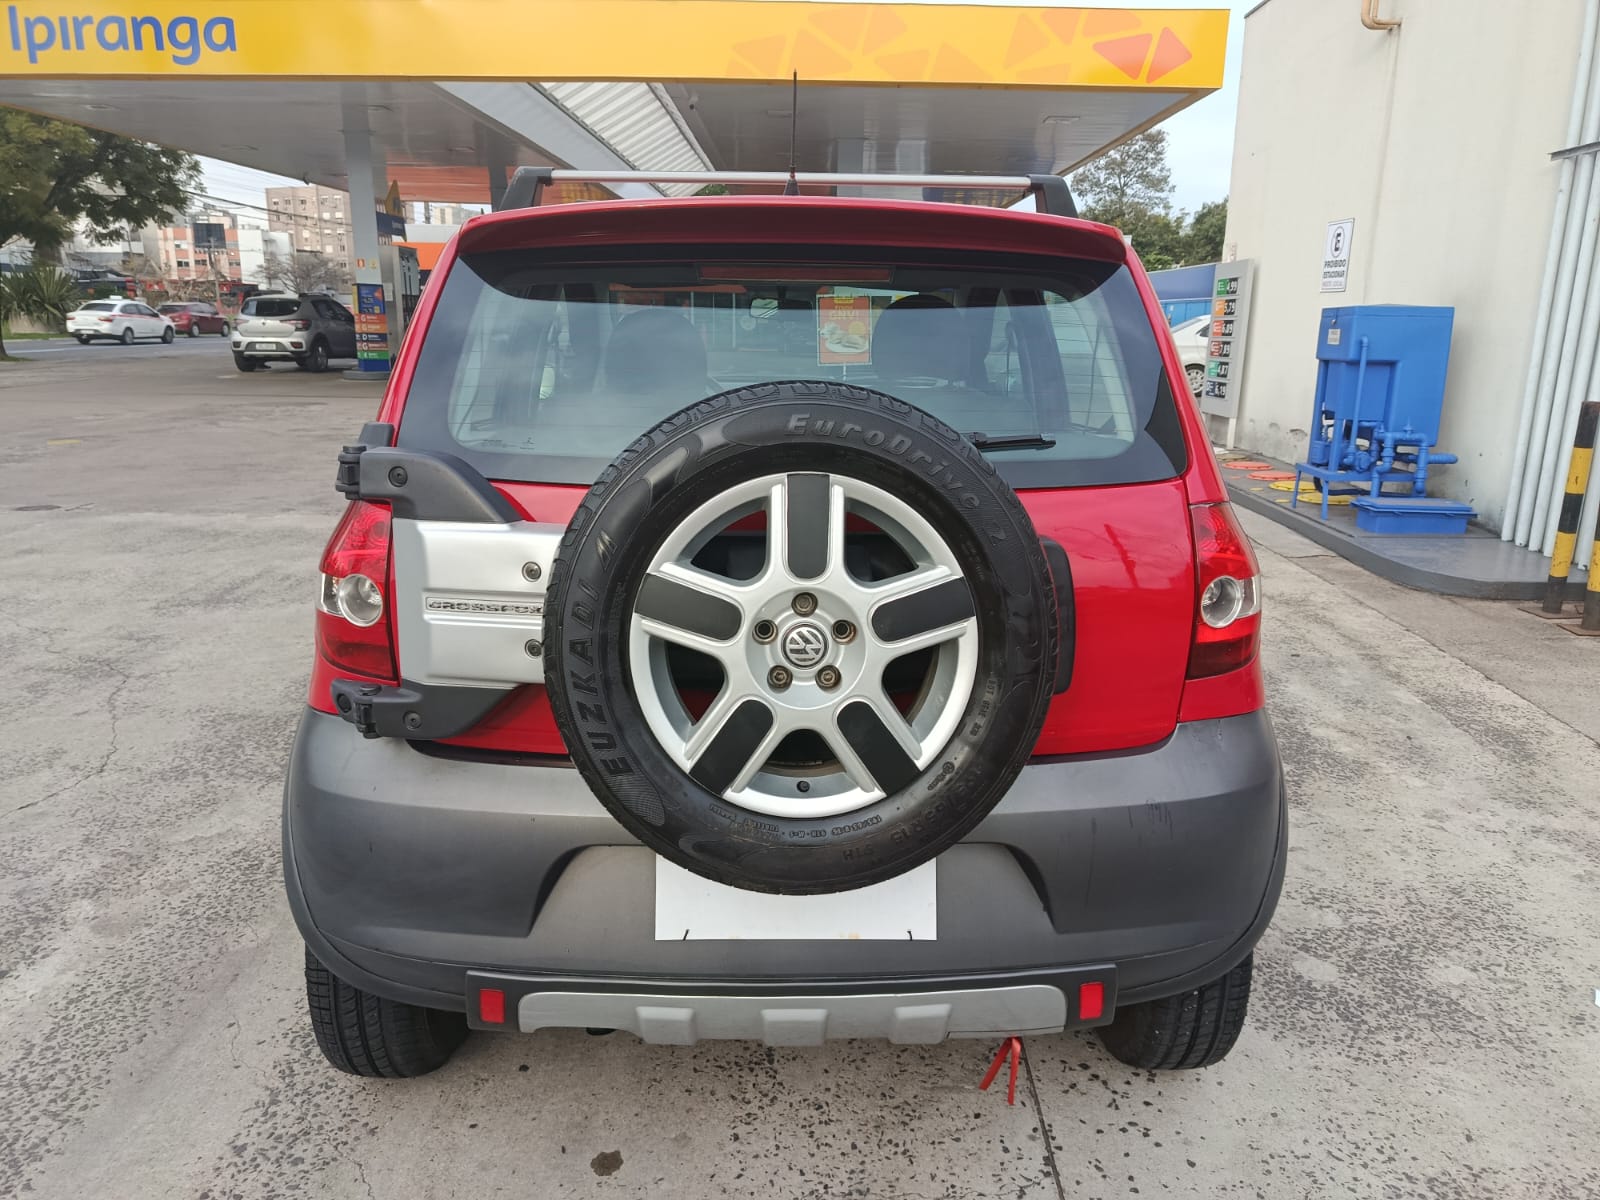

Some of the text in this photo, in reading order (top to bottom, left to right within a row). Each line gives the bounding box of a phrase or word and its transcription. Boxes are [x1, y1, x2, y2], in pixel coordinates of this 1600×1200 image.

[8, 5, 237, 66] Ipiranga
[1324, 259, 1347, 269] PROIBIDO
[785, 413, 980, 510] EuroDrive
[569, 579, 635, 777] EUZKADI
